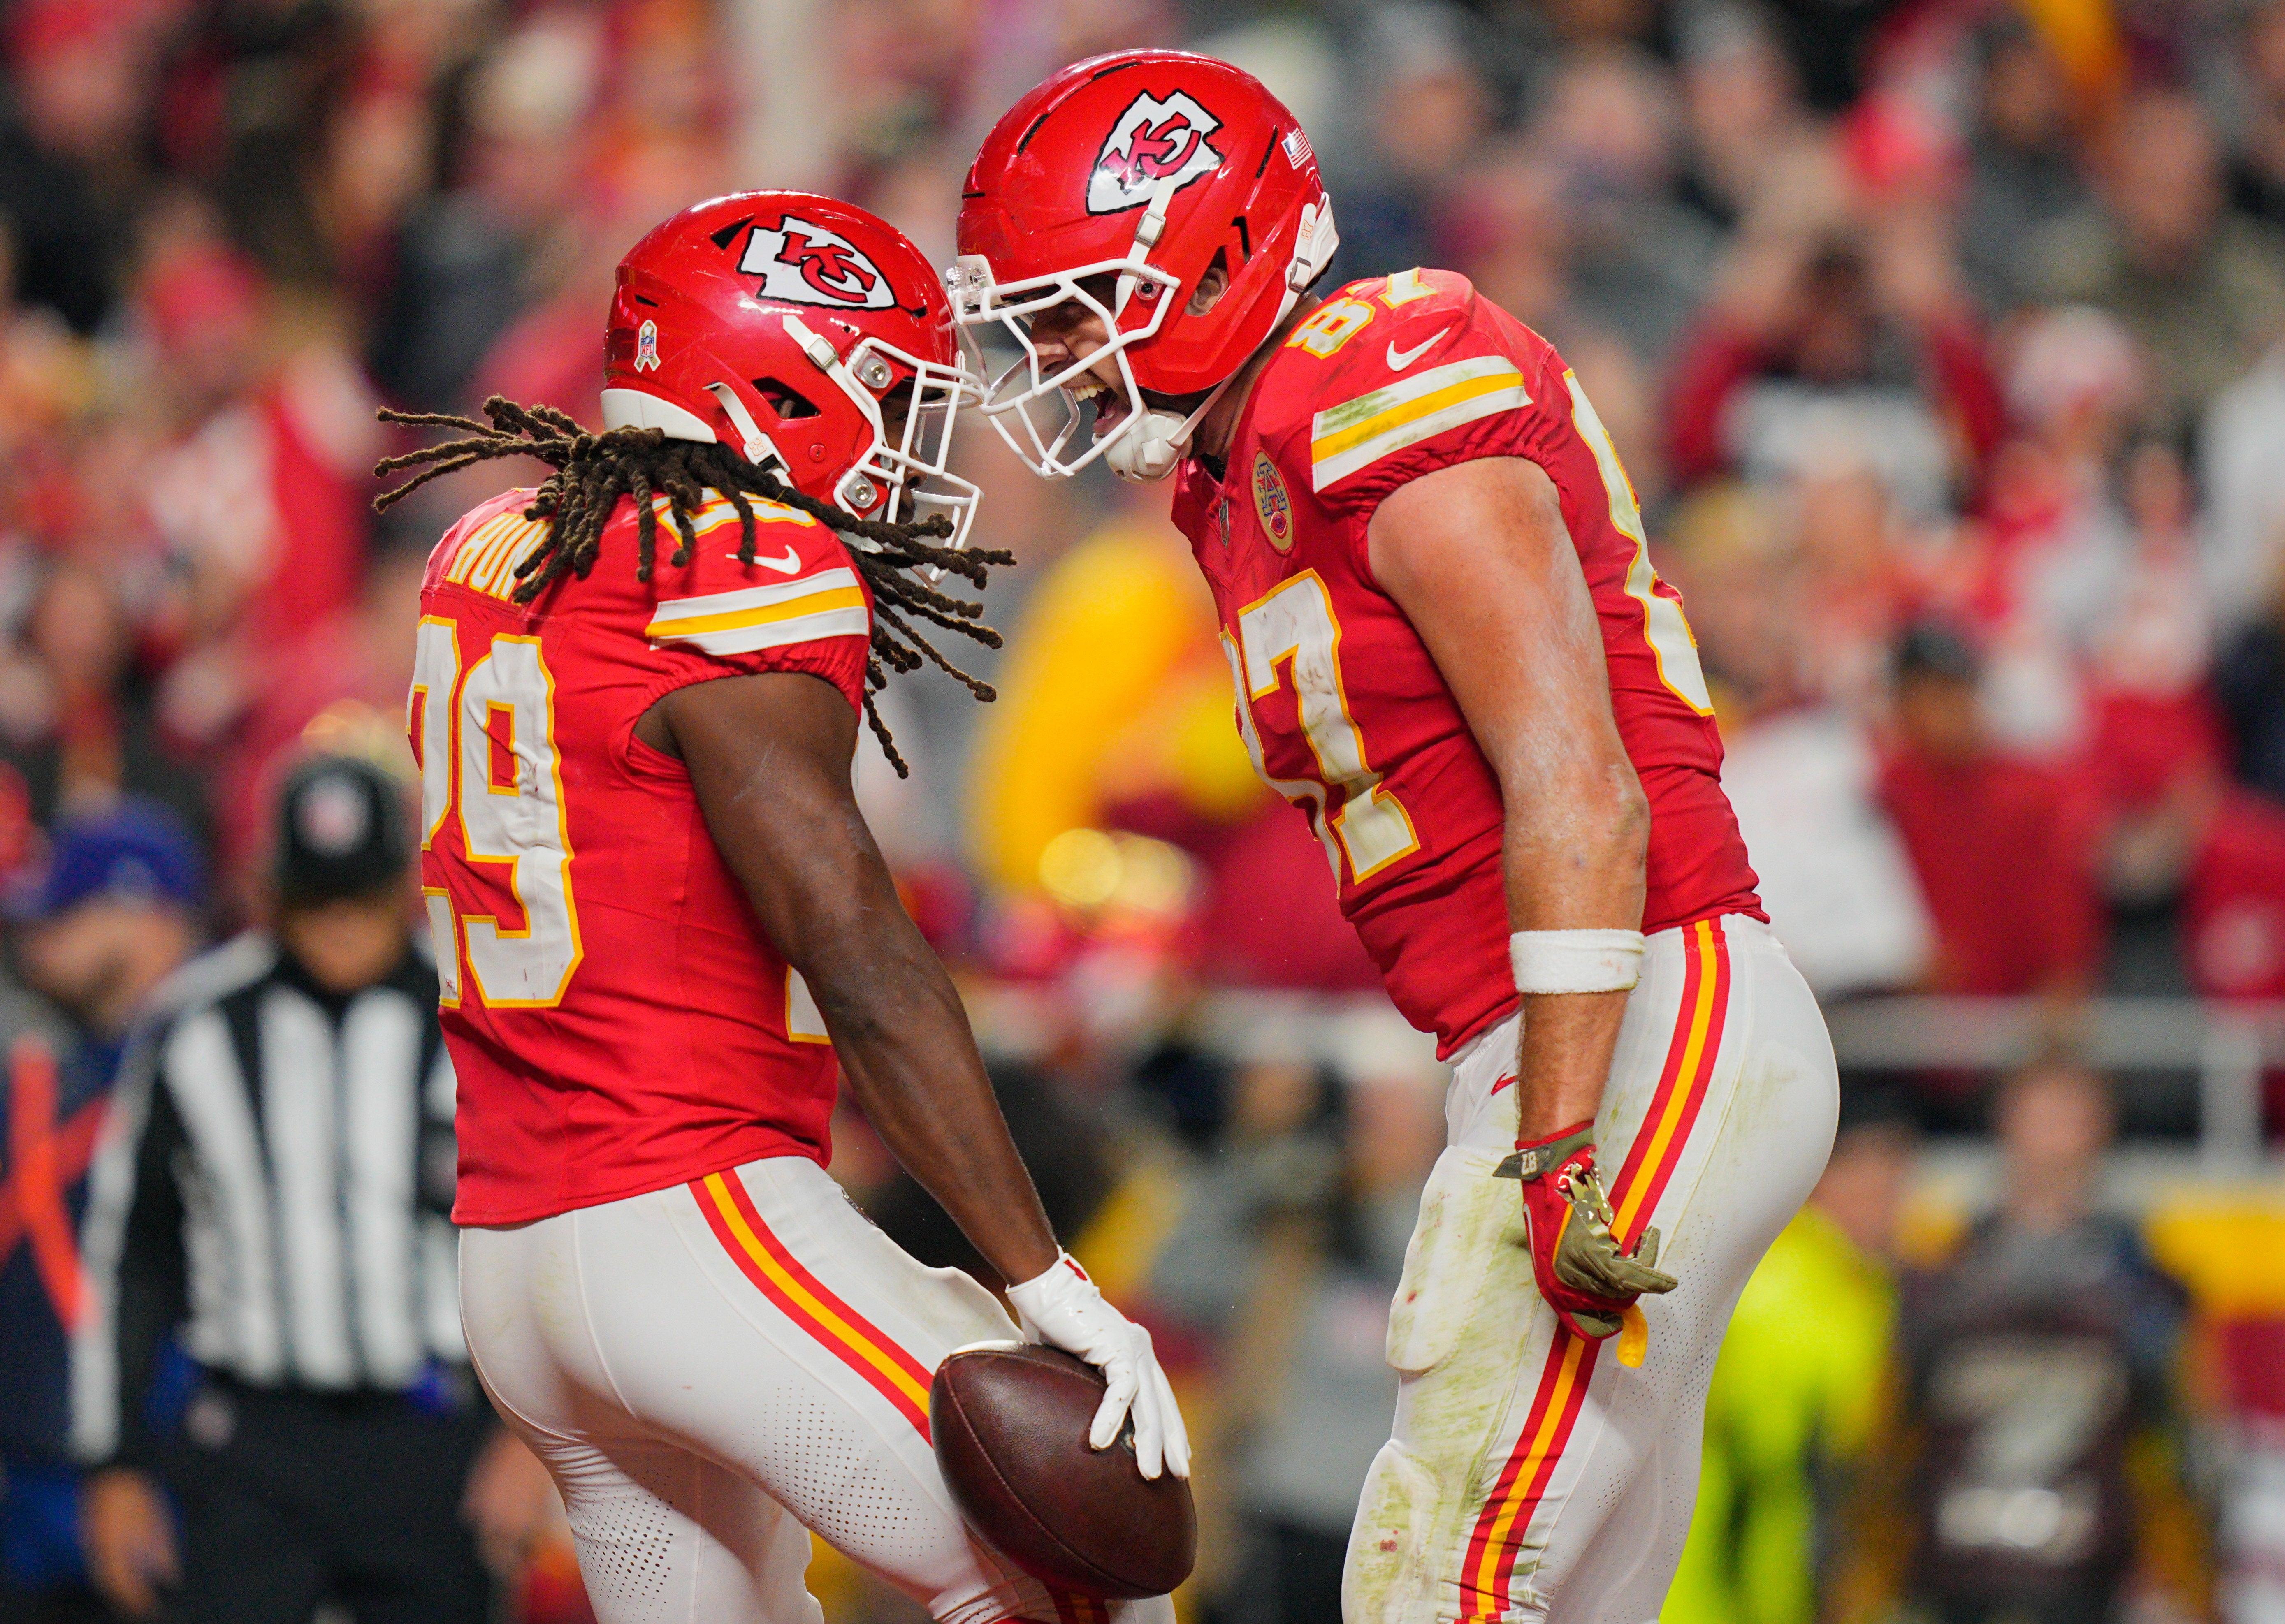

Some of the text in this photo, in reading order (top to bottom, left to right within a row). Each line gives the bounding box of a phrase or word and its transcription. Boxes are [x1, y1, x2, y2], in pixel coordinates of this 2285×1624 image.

[1100, 112, 1202, 195] KC
[1301, 218, 1314, 241] 87
[774, 230, 876, 303] KC
[641, 344, 653, 355] NFL
[747, 436, 767, 456] 29
[446, 513, 554, 606] HUN
[1521, 1151, 1538, 1176] 87
